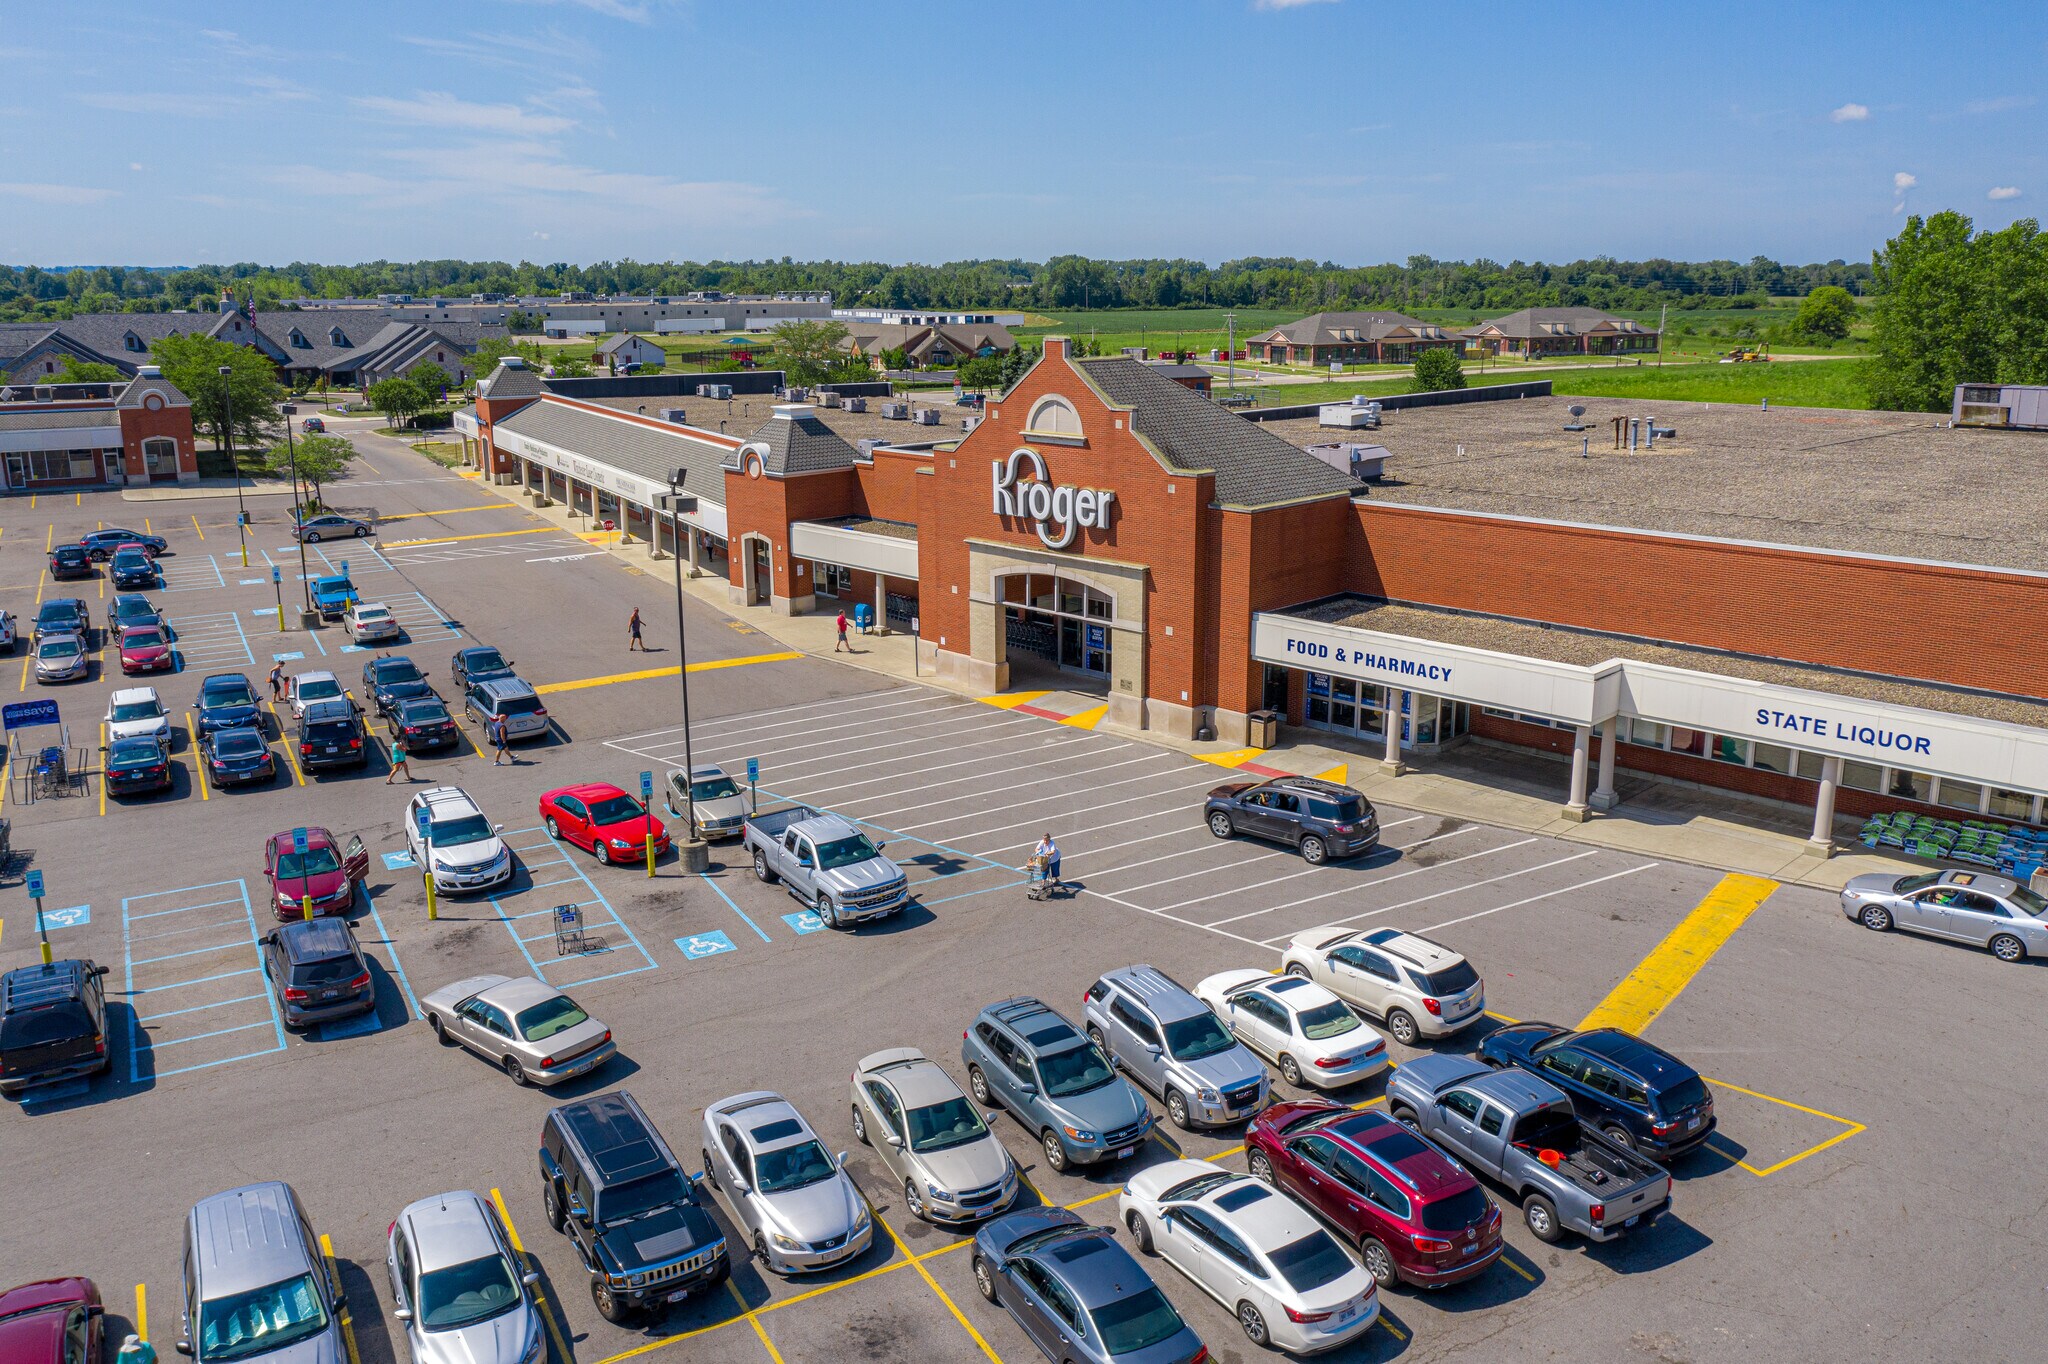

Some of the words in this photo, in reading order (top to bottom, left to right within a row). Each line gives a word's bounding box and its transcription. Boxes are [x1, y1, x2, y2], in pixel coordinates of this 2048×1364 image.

[992, 447, 1115, 549] Kroger
[1287, 638, 1328, 658] FOOD
[1335, 648, 1347, 662] &
[1353, 651, 1452, 681] PHARMACY
[24, 705, 55, 717] save
[1756, 708, 1827, 736] STATE
[1836, 722, 1931, 756] LIQUOR
